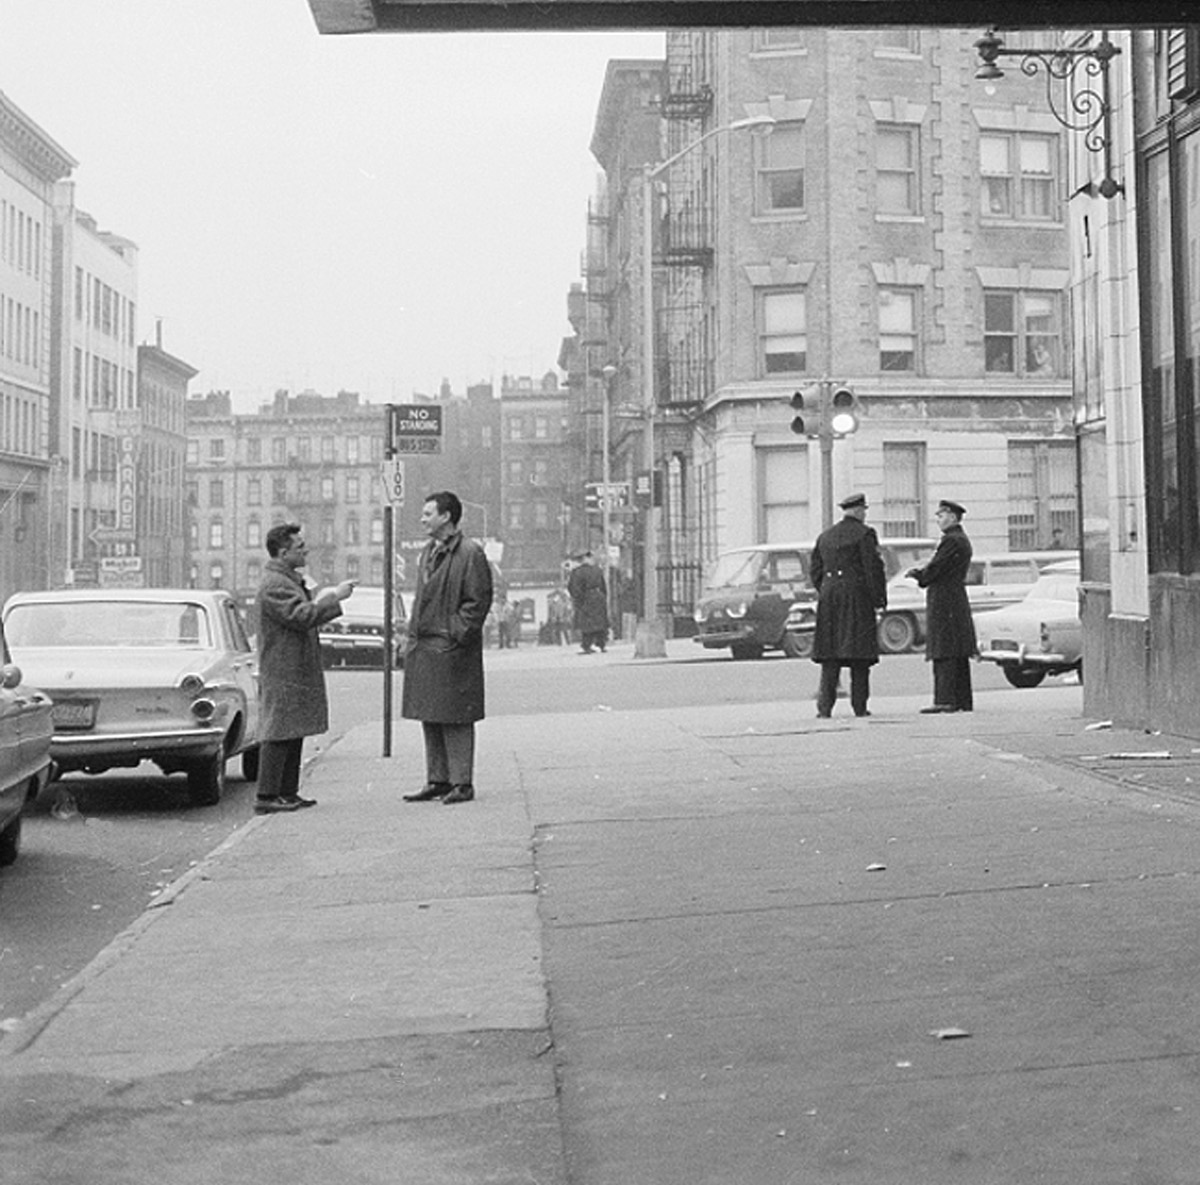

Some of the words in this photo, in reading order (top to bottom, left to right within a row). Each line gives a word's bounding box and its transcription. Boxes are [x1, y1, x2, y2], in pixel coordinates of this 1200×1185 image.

[408, 409, 430, 420] NO
[399, 419, 439, 432] STANDING
[121, 435, 134, 530] GARAGE
